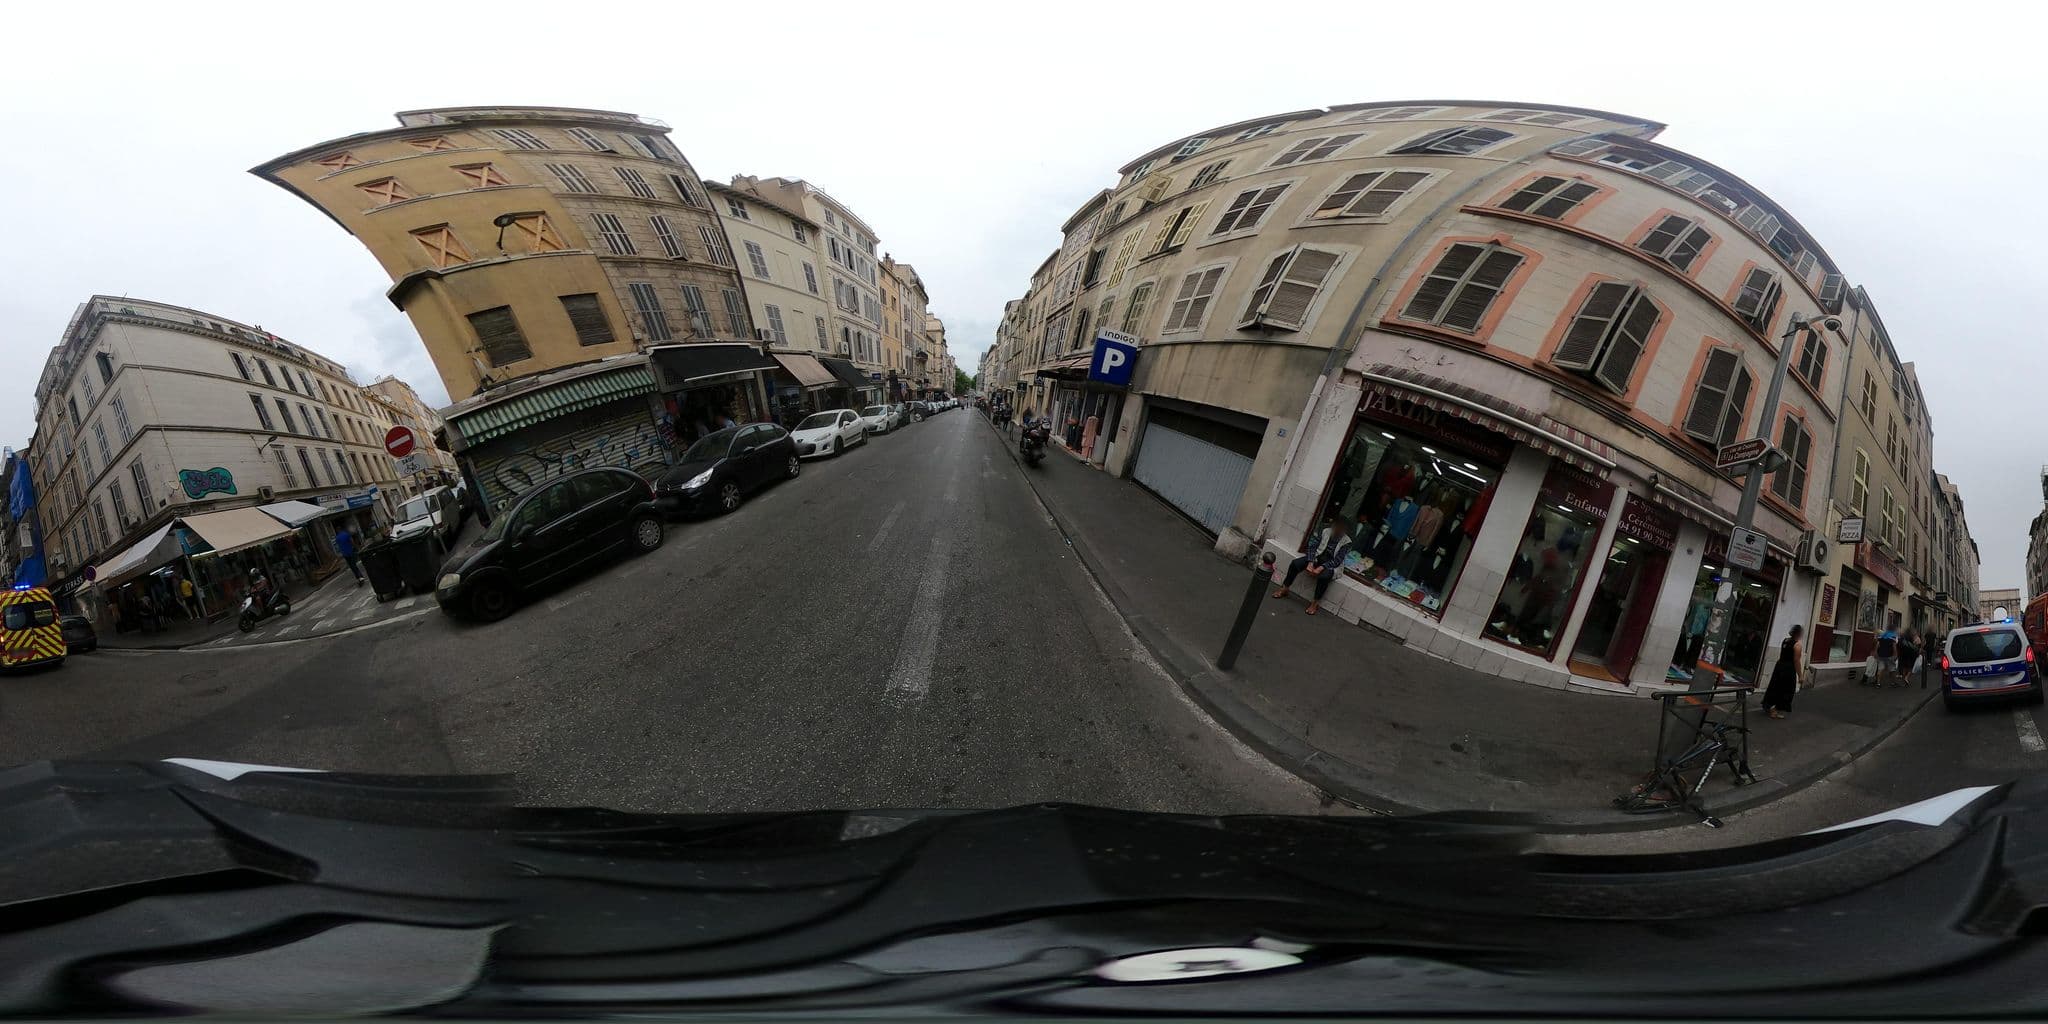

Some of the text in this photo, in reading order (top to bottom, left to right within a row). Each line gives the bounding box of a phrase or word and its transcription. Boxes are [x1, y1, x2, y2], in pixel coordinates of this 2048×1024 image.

[1104, 330, 1135, 344] INDIGO
[1101, 348, 1126, 375] P
[1358, 390, 1438, 427] JAXIM
[1565, 492, 1608, 519] Enfants
[1626, 494, 1639, 506] Le
[64, 575, 84, 592] STRASS
